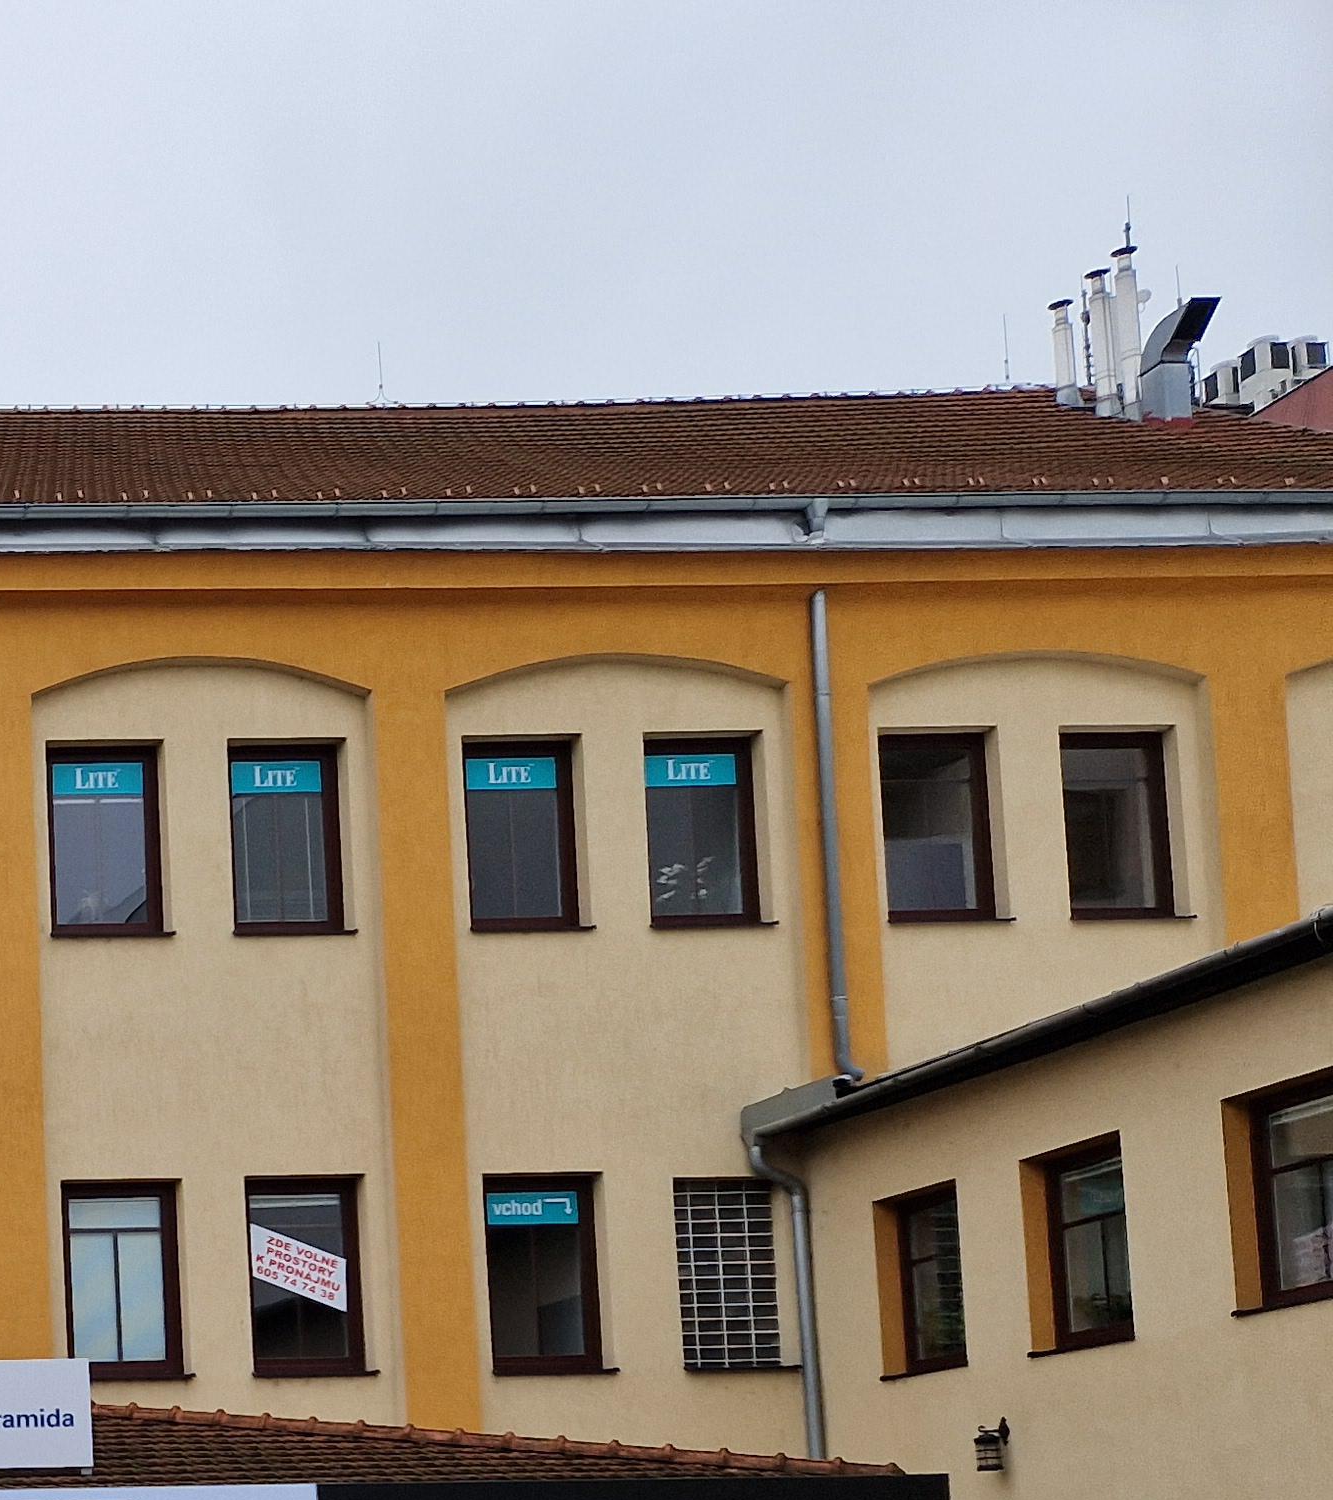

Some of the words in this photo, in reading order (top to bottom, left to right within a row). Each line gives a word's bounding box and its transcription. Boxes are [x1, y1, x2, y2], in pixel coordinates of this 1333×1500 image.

[492, 1199, 543, 1216] vchod
[266, 1236, 292, 1251] ZDE
[256, 1254, 265, 1264] K
[266, 1247, 335, 1278] PROSTORY
[256, 1265, 279, 1280] 605
[283, 1275, 297, 1286] 74
[302, 1282, 316, 1293] 74
[320, 1289, 335, 1301] 38
